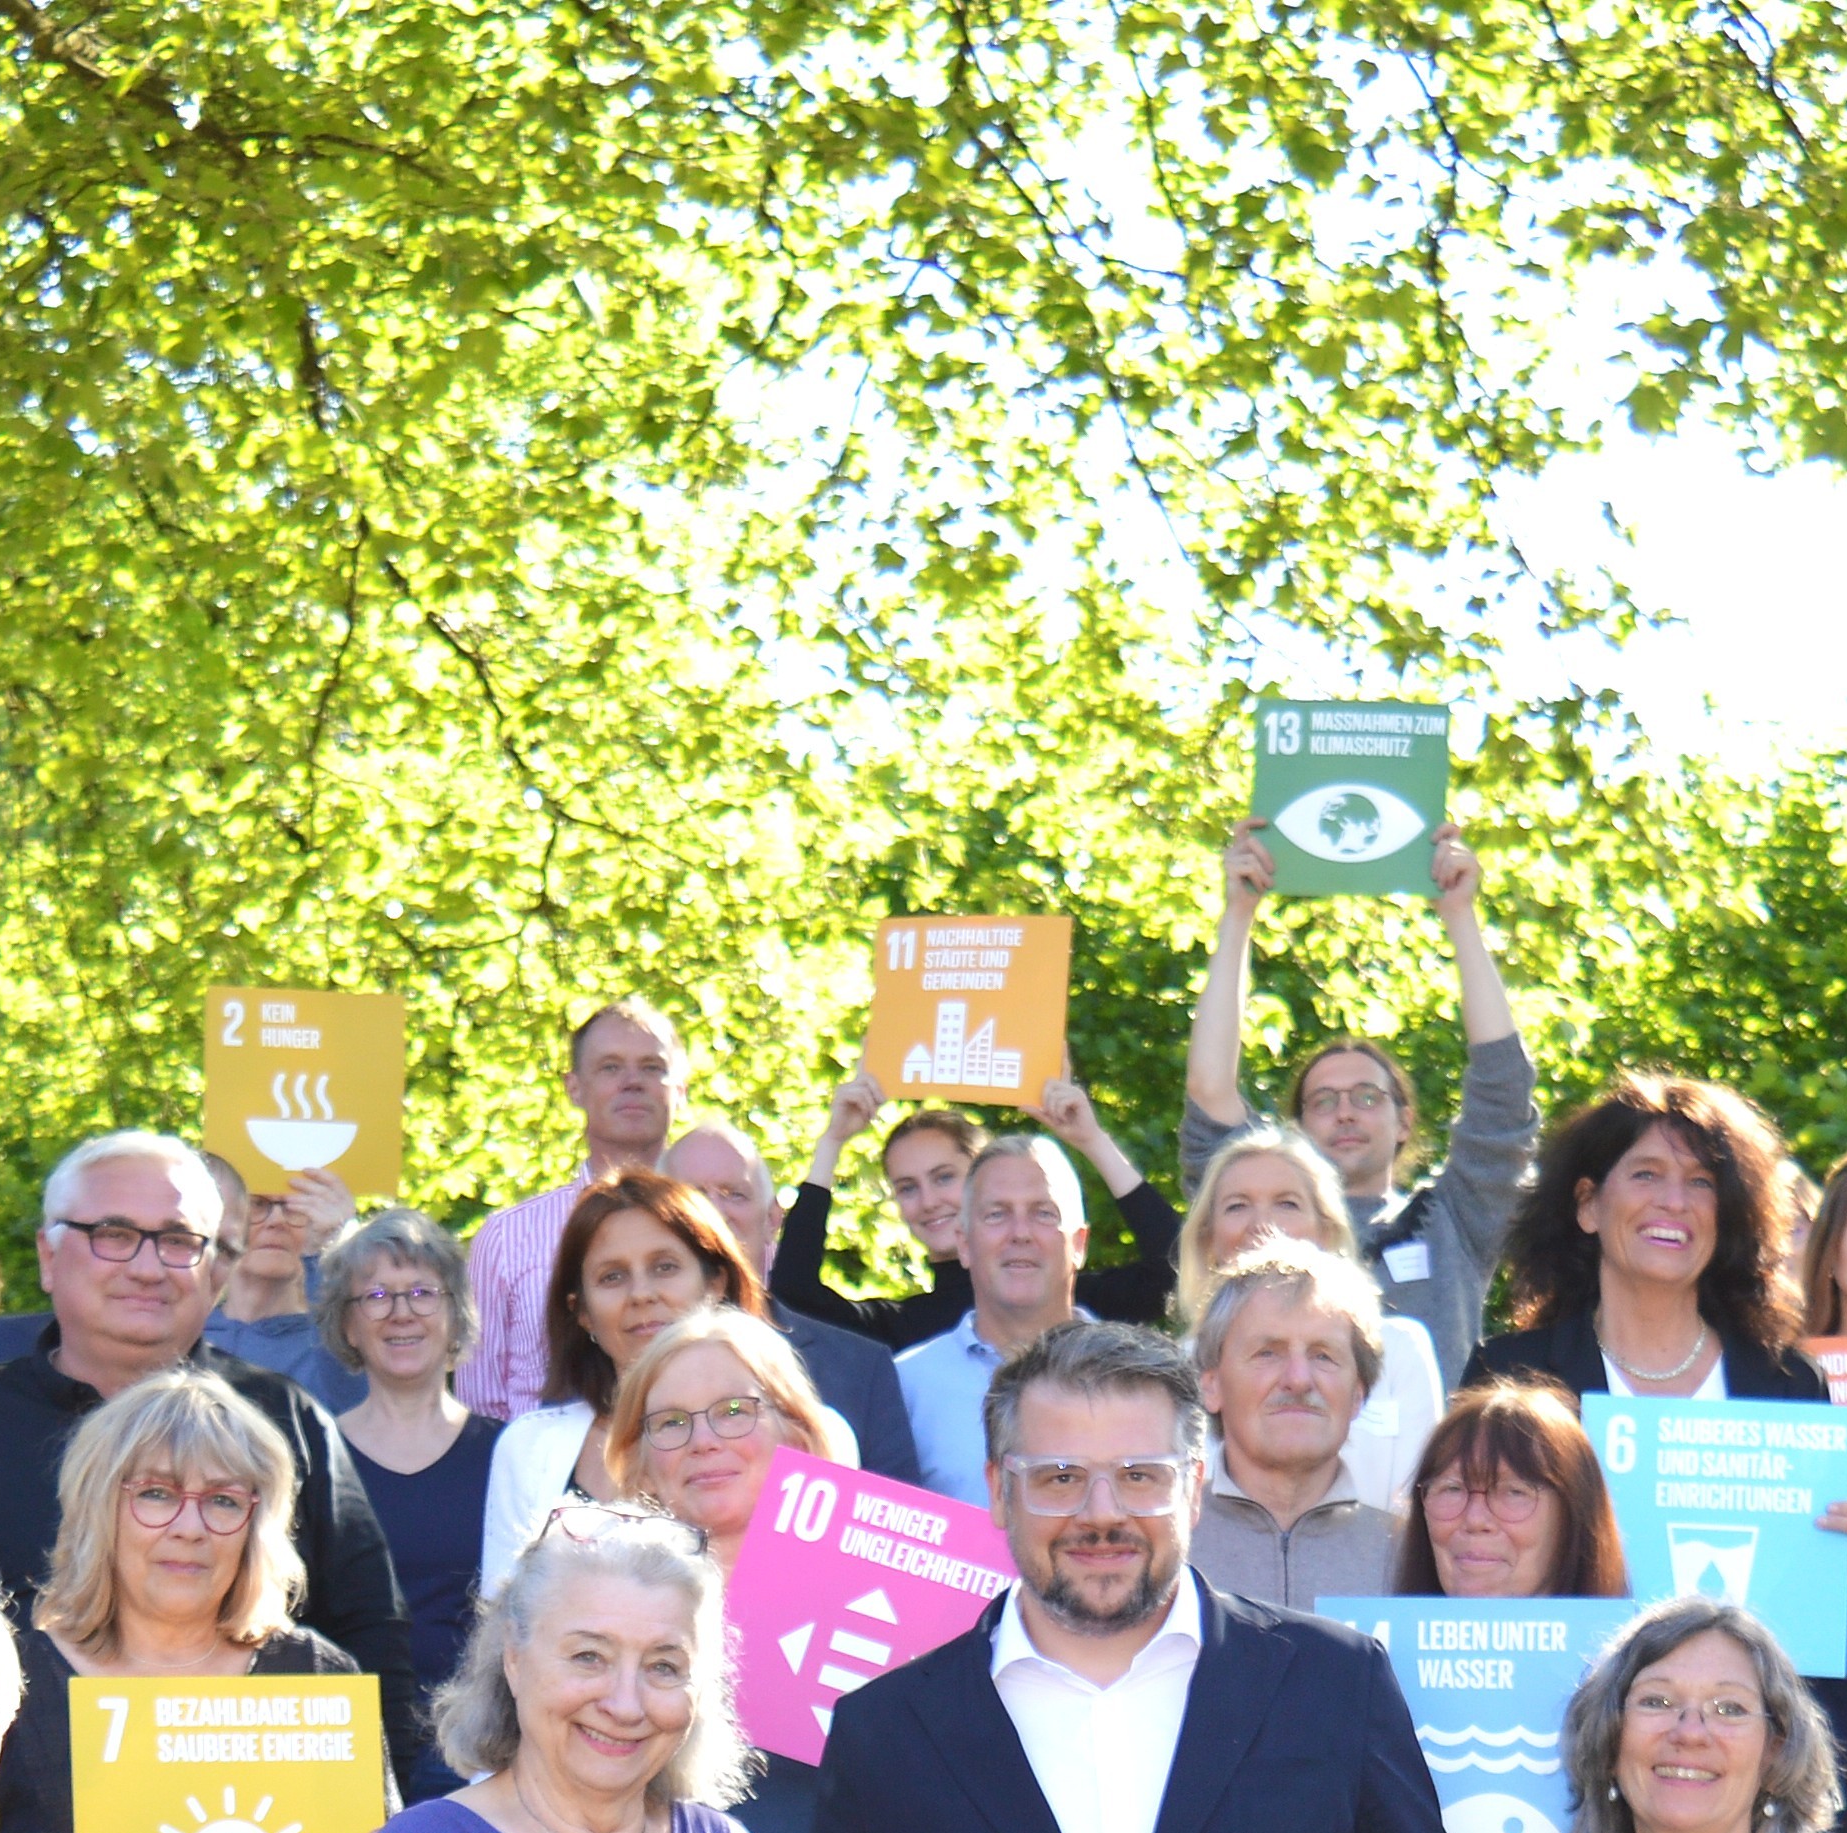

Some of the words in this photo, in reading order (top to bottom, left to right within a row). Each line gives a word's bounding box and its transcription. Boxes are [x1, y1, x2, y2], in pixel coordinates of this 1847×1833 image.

[1264, 711, 1300, 755] 13
[1311, 712, 1413, 733] MASSNAHMEN
[1415, 716, 1447, 736] ZUM
[1310, 735, 1410, 757] KLIMASCHUTZ
[887, 931, 916, 971] 11
[926, 928, 1023, 947] NACHHALTIGE
[924, 948, 977, 969] STÄDTE
[979, 950, 1009, 968] UND
[922, 972, 1003, 991] GEMEINDEN
[222, 1001, 245, 1046] 2
[261, 1004, 296, 1023] KEIN
[261, 1028, 321, 1049] HUNGER
[1605, 1414, 1636, 1474] 6
[1657, 1417, 1762, 1448] SAUBERES
[1765, 1422, 1847, 1451] WASSER
[1657, 1449, 1701, 1476] UND
[1701, 1448, 1794, 1480] SANITÄR-
[774, 1472, 838, 1542] 10
[853, 1492, 948, 1546] WENIGER
[1656, 1481, 1812, 1514] EINRICHTUNGEN
[1418, 1621, 1490, 1650] LEBEN
[1492, 1621, 1567, 1651] UNTER
[1417, 1659, 1514, 1689] WASSER
[98, 1697, 129, 1763] 7
[155, 1697, 300, 1727] BEZAHLBARE
[303, 1697, 351, 1725] UND
[157, 1733, 259, 1762] SAUBERE
[263, 1732, 355, 1761] ENERGIE
